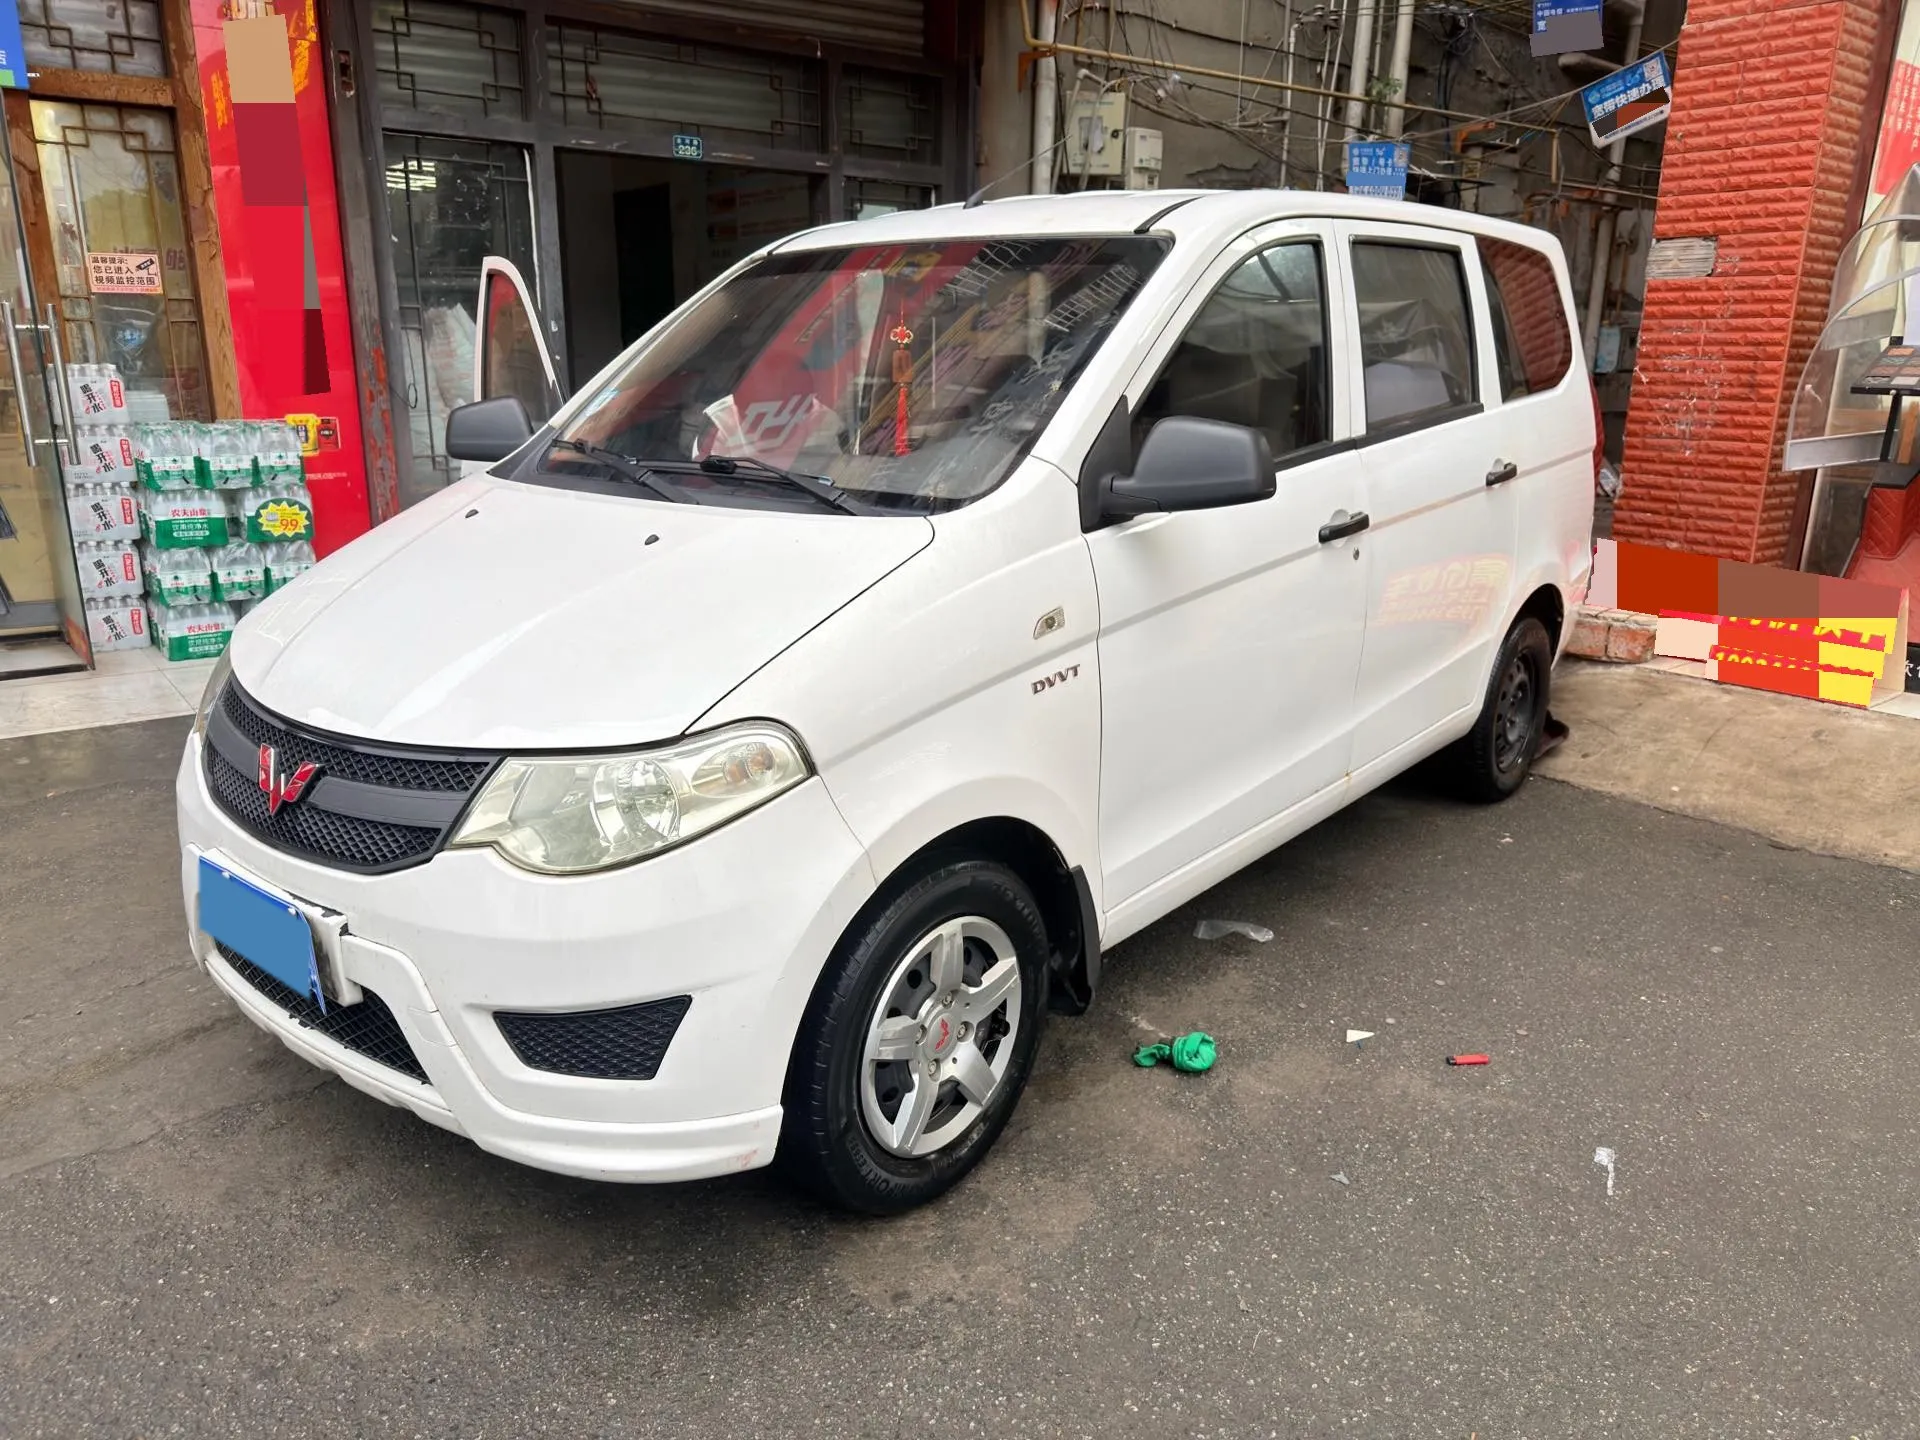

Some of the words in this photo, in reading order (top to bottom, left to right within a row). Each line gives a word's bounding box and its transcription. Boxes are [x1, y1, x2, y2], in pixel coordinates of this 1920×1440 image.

[93, 265, 134, 275] 您已进入
[94, 275, 156, 286] 视频监控范围
[1030, 663, 1081, 695] DVVT
